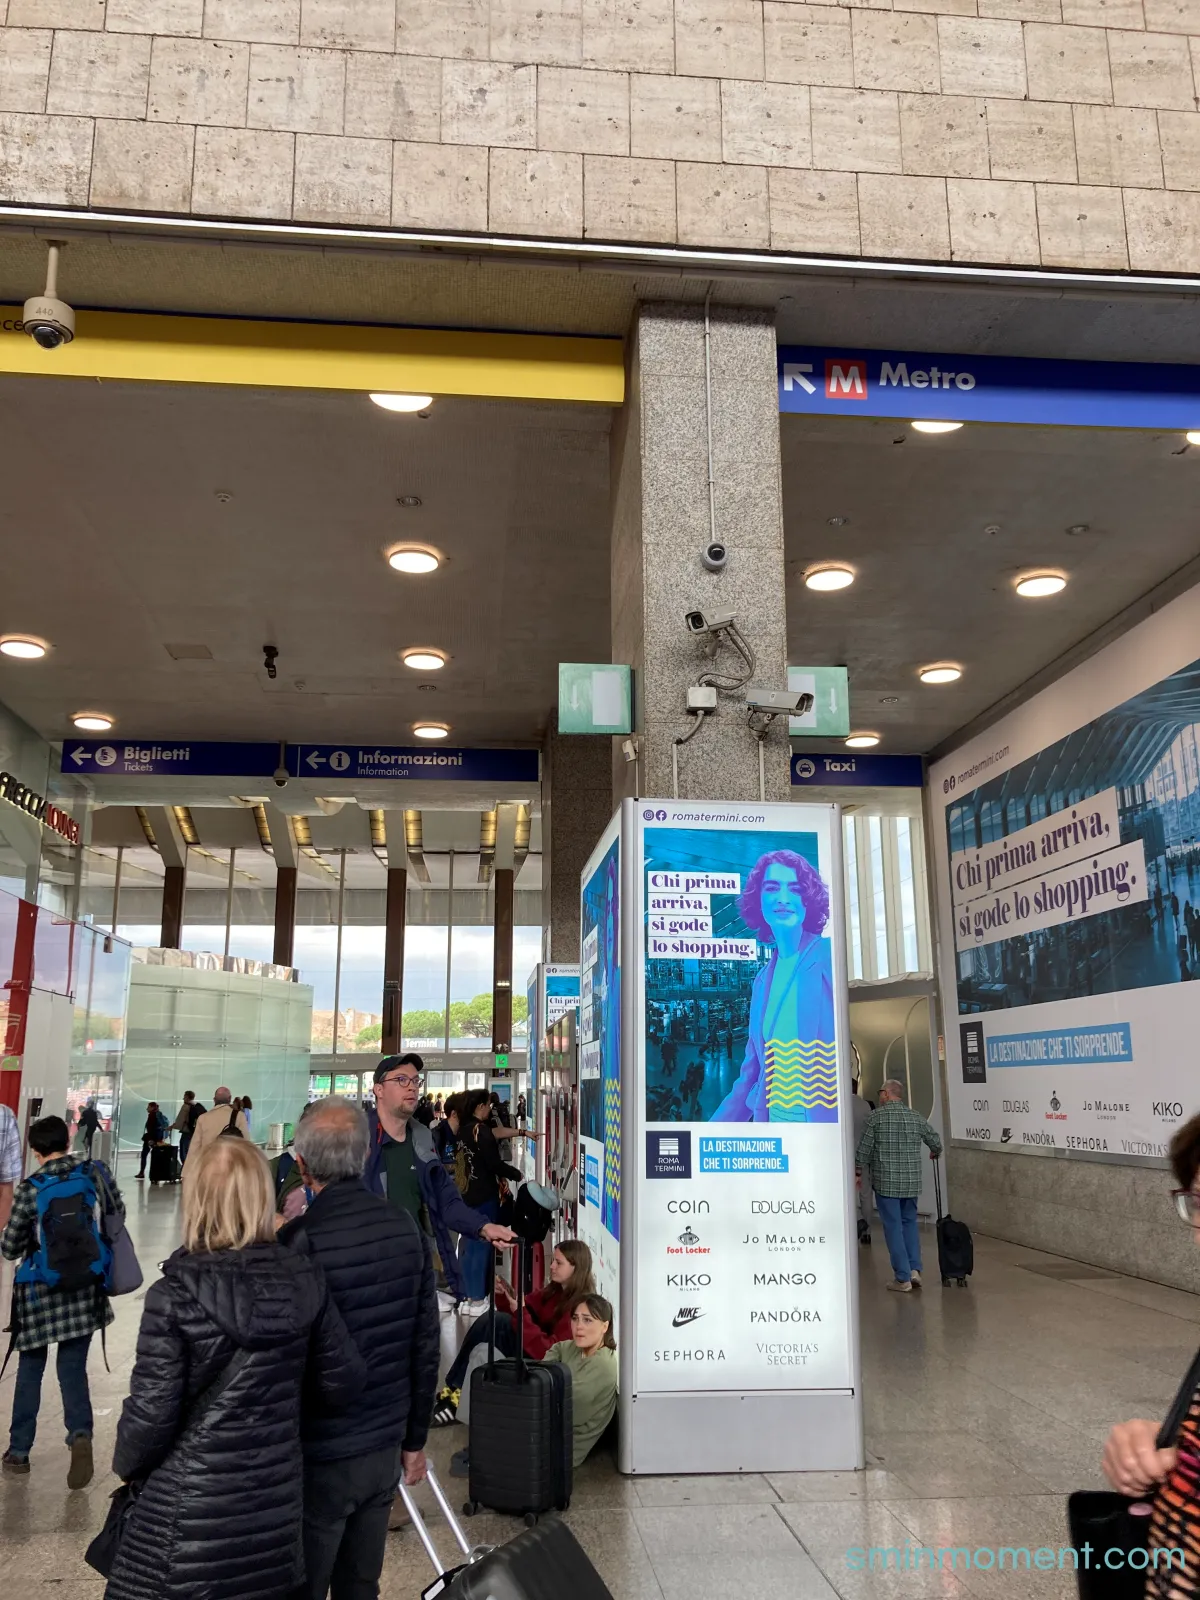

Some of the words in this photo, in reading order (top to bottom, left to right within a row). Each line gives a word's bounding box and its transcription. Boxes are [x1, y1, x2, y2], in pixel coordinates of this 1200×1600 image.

[35, 307, 54, 316] 440
[829, 365, 864, 394] M
[879, 362, 976, 391] Metro
[124, 746, 190, 763] Biglietti
[358, 750, 463, 765] Informazioni
[124, 762, 153, 772] Tickets
[357, 766, 409, 776] Information
[823, 758, 856, 772] Taxi
[957, 745, 1010, 784] romatermini.com
[672, 812, 765, 824] romatermini.com
[956, 853, 981, 890] Chi
[985, 841, 1037, 891] prima
[1041, 810, 1110, 858] arriva,
[651, 874, 680, 889] Chi
[685, 875, 737, 893] prima
[651, 896, 709, 911] arriva,
[959, 906, 971, 937] si
[974, 899, 1011, 943] gode
[1014, 892, 1030, 920] lo
[1033, 859, 1137, 918] shopping.
[652, 917, 665, 931] si
[669, 918, 709, 934] gode
[653, 939, 667, 953] lo
[671, 940, 755, 959] shopping.
[404, 1038, 438, 1048] Termini
[990, 1043, 998, 1062] LA
[999, 1038, 1047, 1062] DESTINAZIONE
[1048, 1036, 1064, 1059] CHE
[1064, 1036, 1073, 1058] TI
[1074, 1031, 1128, 1058] SORPRENDE.
[1152, 1102, 1183, 1116] KIKO
[966, 1128, 990, 1140] MANGO
[703, 1141, 713, 1152] LA
[716, 1140, 776, 1153] DESTINAZIONE
[1066, 1136, 1108, 1151] SEPHORA
[703, 1158, 721, 1169] CHE
[723, 1158, 731, 1169] TI
[732, 1158, 785, 1170] SORPRENDE.
[752, 1200, 815, 1214] DOUGLAS
[743, 1234, 760, 1244] Jo
[766, 1234, 826, 1244] MALONE
[667, 1246, 683, 1254] Foot
[685, 1246, 711, 1254] Locker
[667, 1274, 712, 1286] KIKO
[754, 1273, 816, 1285] MANGO
[677, 1307, 700, 1318] NIKE
[654, 1349, 726, 1361] SEPHORA
[756, 1343, 819, 1354] VICTORIA'S
[767, 1354, 808, 1366] SECRET
